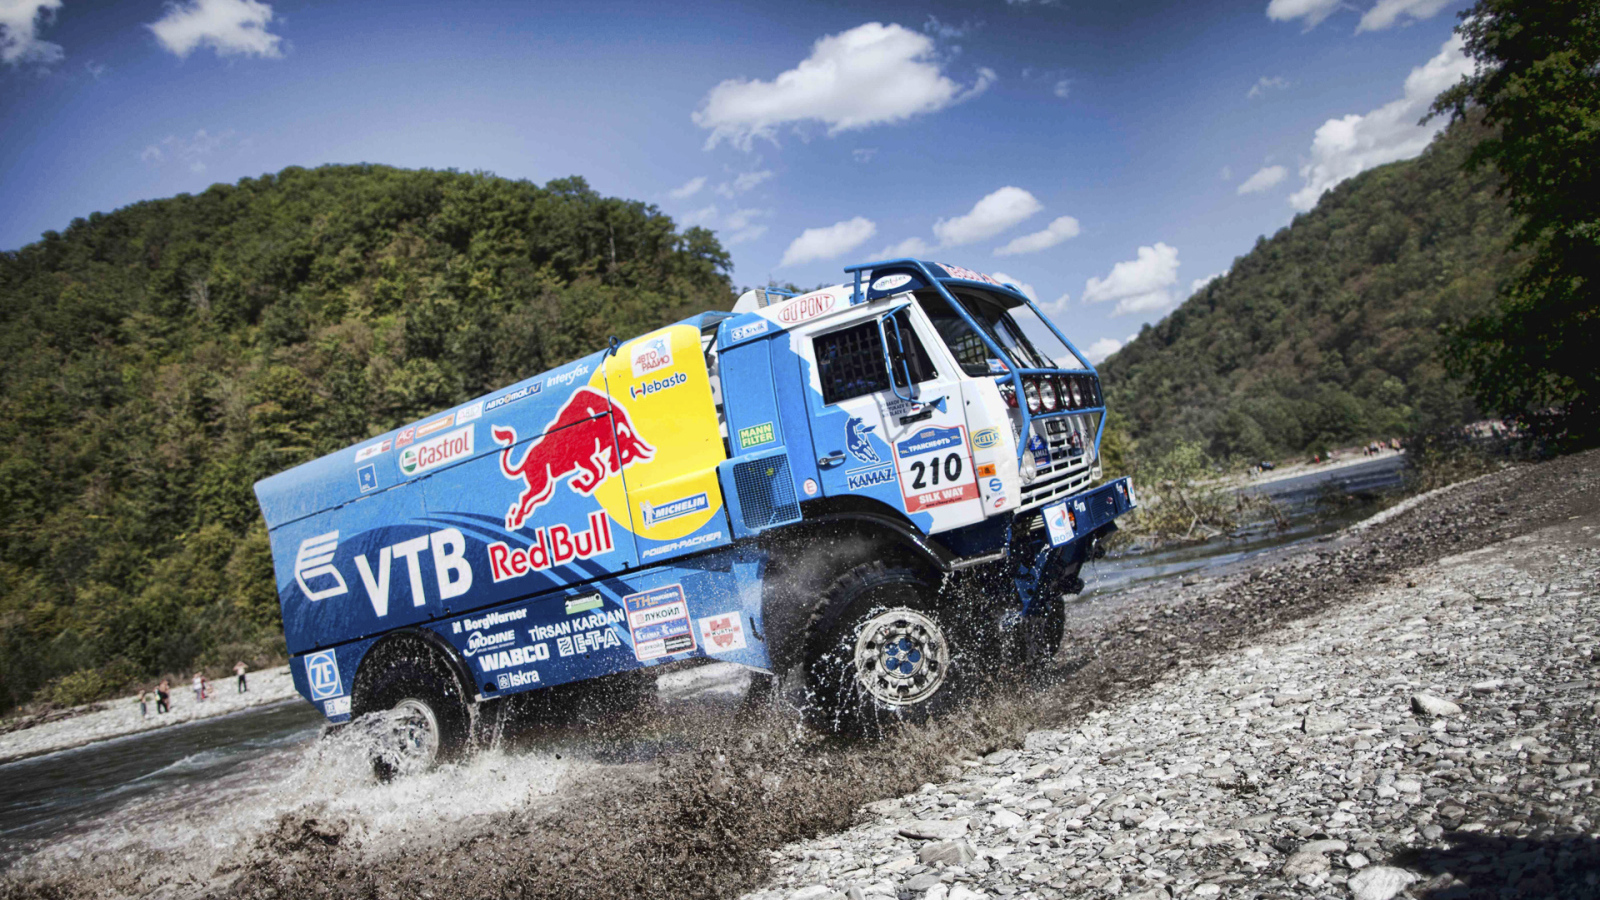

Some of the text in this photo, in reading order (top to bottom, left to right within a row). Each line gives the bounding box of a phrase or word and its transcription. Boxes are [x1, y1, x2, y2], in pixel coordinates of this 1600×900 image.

[641, 354, 670, 372] РАДИО
[740, 423, 772, 439] MANN
[742, 432, 773, 447] FILTER
[418, 431, 470, 467] Castrol
[848, 468, 894, 490] KAMAZ
[910, 452, 962, 490] 210
[918, 486, 964, 504] SILK WAY
[655, 496, 705, 518] MICHELIN
[489, 511, 613, 581] Red Bull
[642, 531, 722, 559] POWER-PACKER
[354, 528, 473, 617] VTB
[463, 608, 527, 631] BorgWarner
[572, 608, 625, 632] KARDAN
[645, 607, 680, 621] ЛУКОЙЛ
[469, 629, 515, 649] MODINE
[478, 642, 550, 672] WABCO
[310, 660, 336, 689] ZF
[508, 670, 540, 687] Iskra
